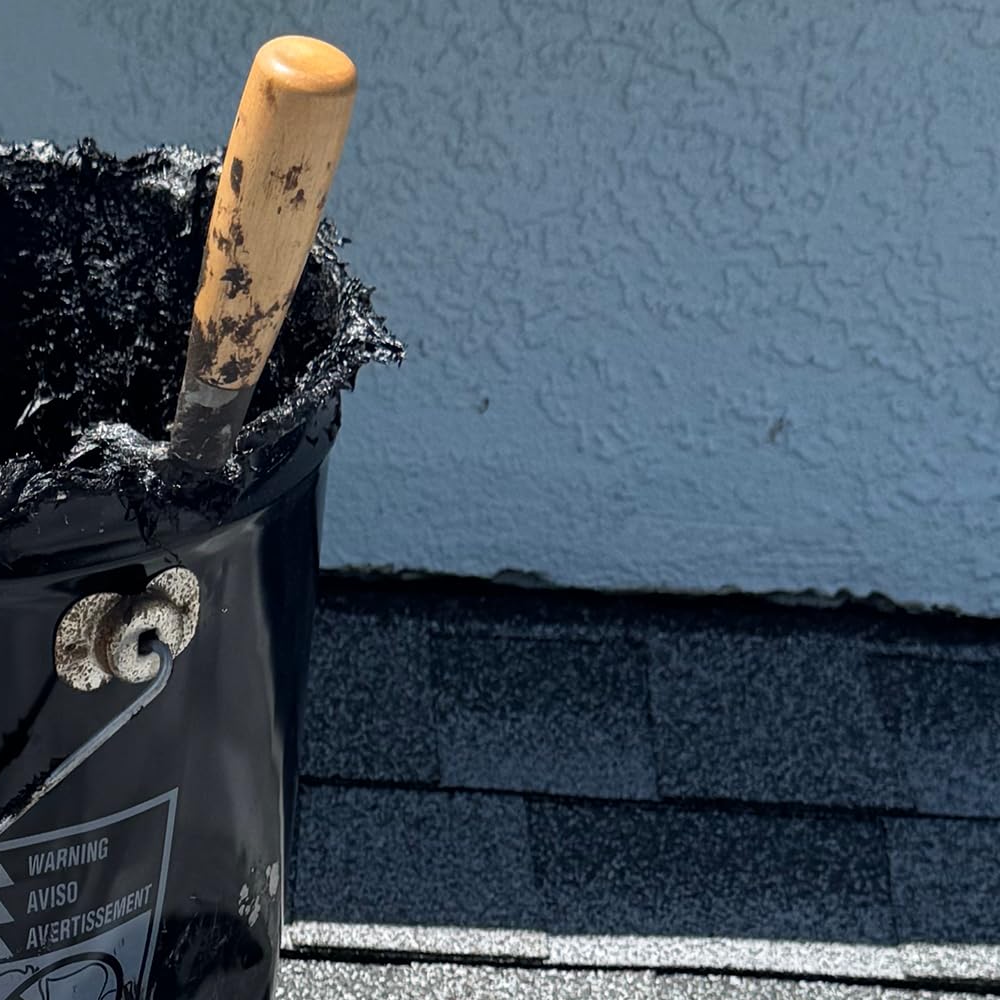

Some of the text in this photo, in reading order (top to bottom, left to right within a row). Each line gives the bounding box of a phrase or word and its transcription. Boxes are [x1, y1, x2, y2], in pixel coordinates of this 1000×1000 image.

[28, 837, 109, 876] WARNING
[26, 881, 78, 914] AVISO
[26, 884, 152, 950] AVERTISSEMENT
